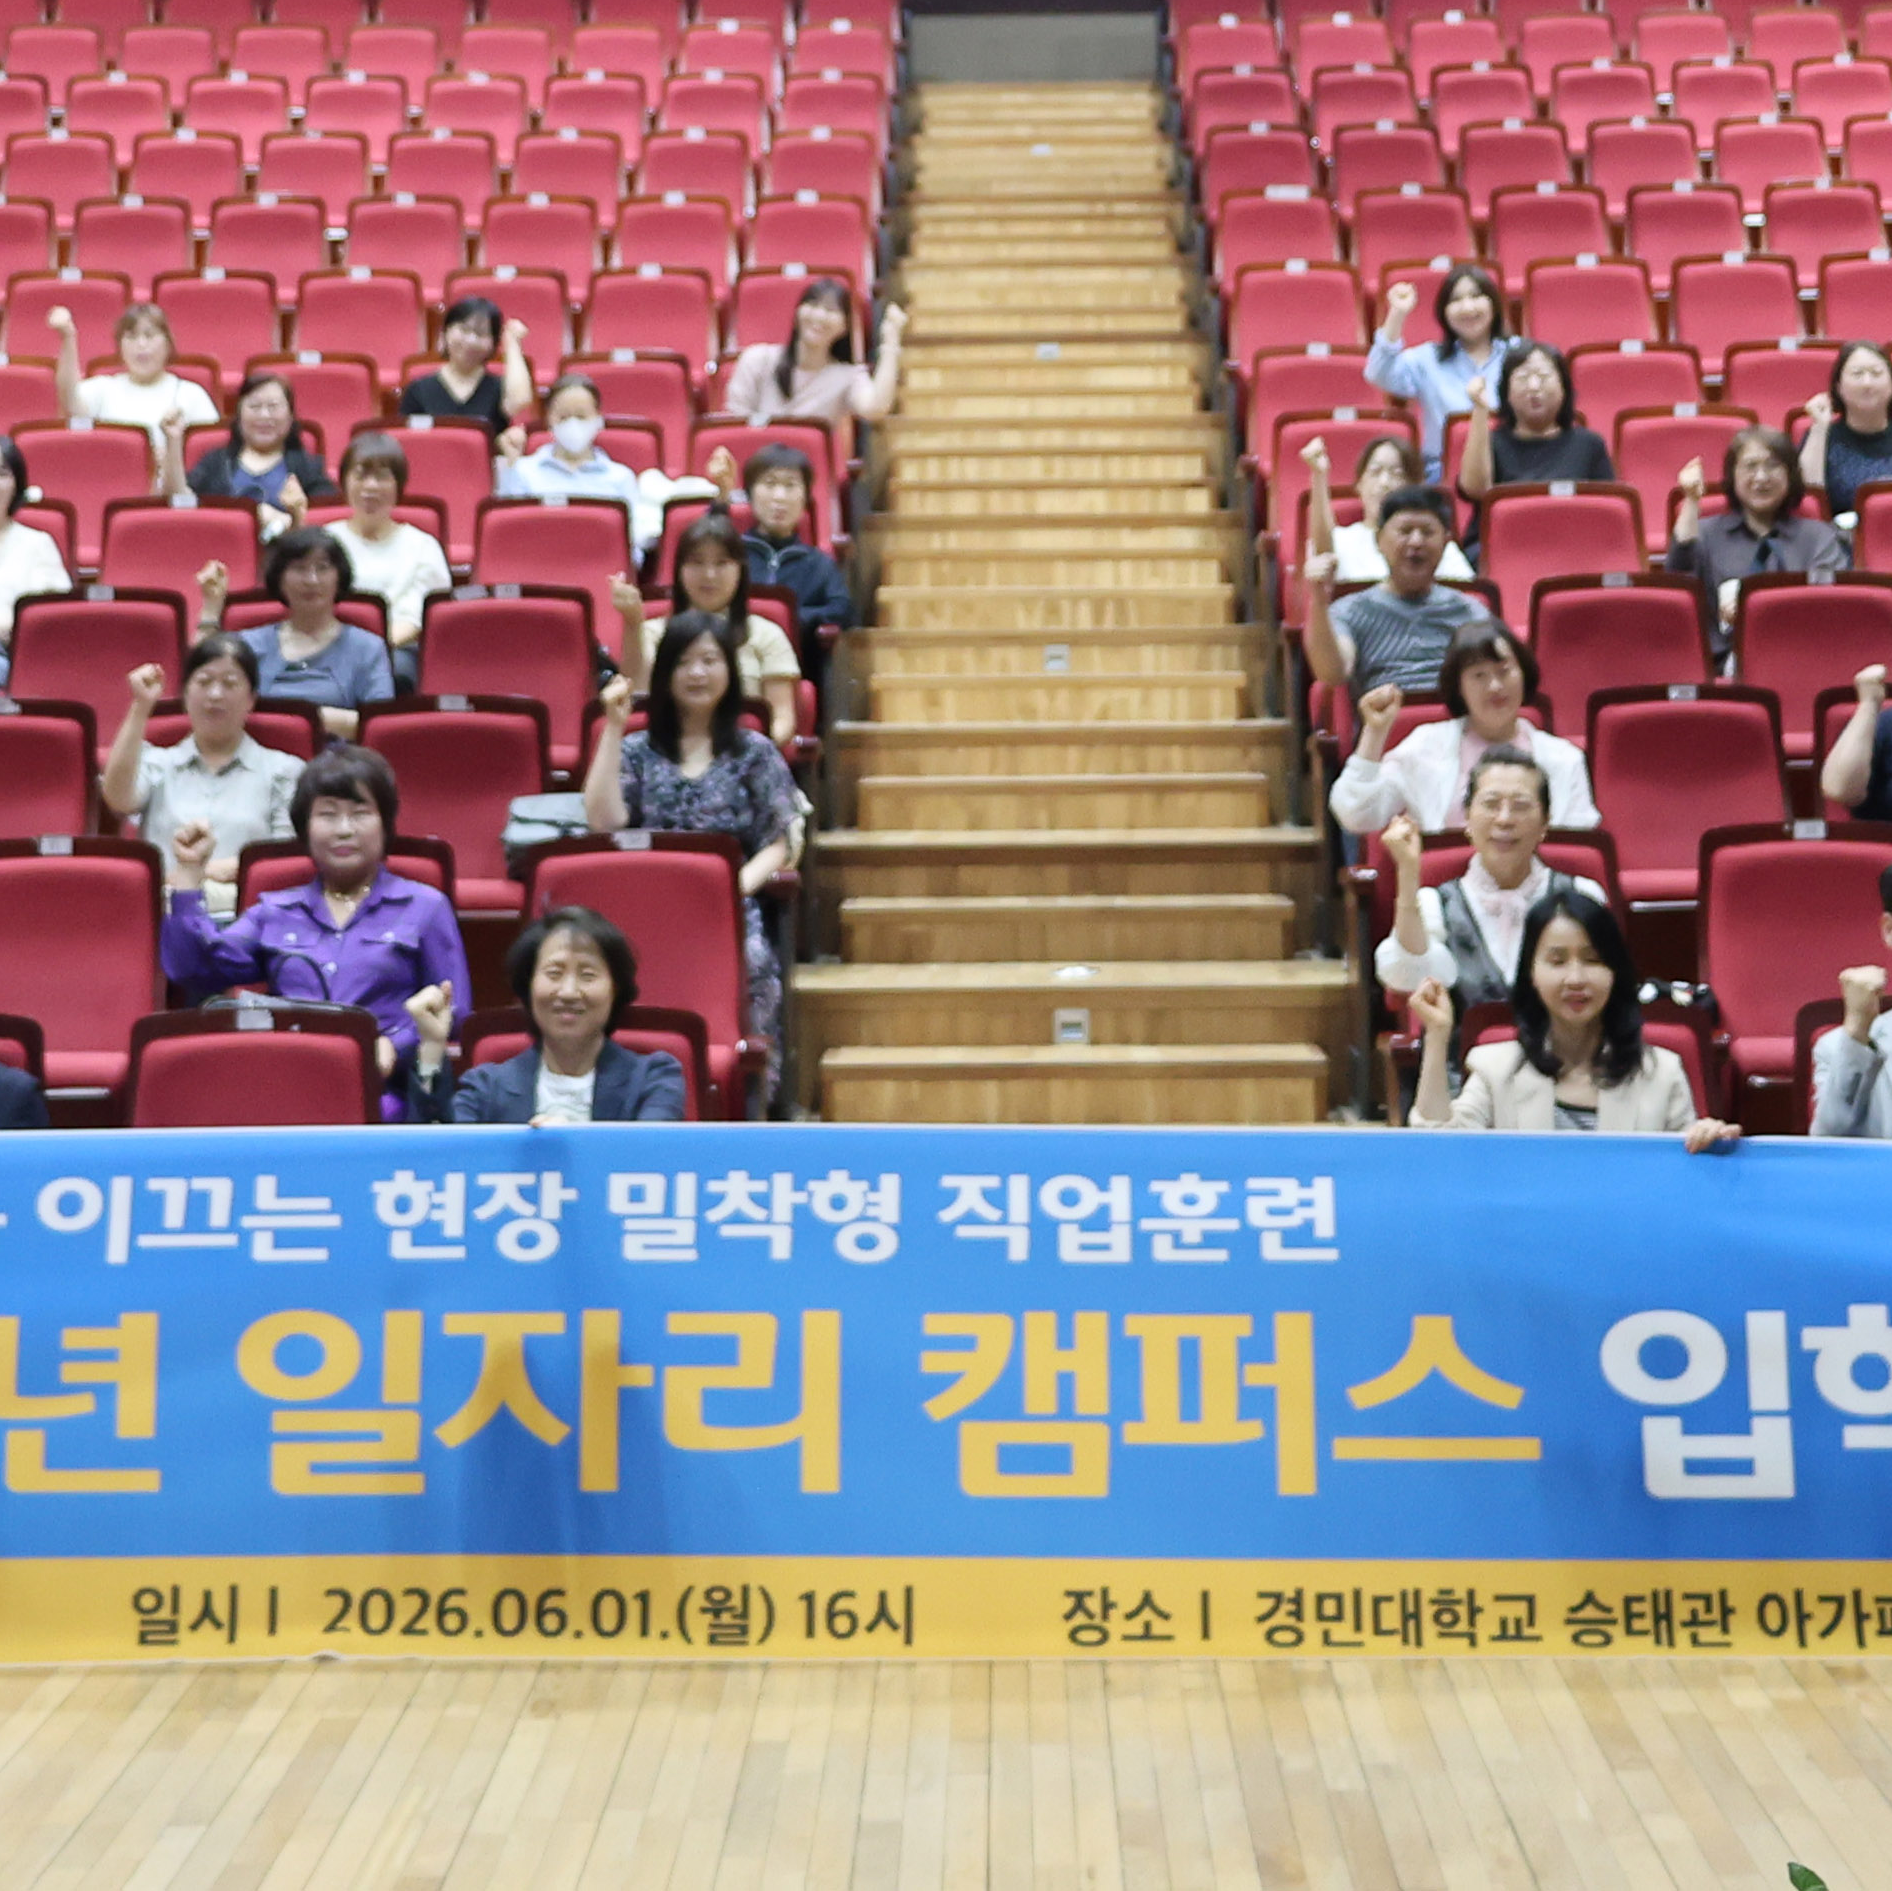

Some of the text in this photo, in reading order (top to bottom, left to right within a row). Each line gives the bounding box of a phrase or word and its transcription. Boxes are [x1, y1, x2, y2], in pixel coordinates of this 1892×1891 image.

[35, 1173, 344, 1266] 이끄는
[370, 1168, 580, 1264] 현장
[606, 1168, 903, 1266] 밀착형
[936, 1171, 1341, 1265] 직업훈련
[234, 1307, 844, 1498] 일자리
[918, 1308, 1543, 1500] 캠퍼스
[131, 1583, 914, 1647] 일시 2026.06.01.(월) 16시
[1062, 1586, 1175, 1648] 장소
[1255, 1587, 1543, 1649] 경민대학교
[1563, 1587, 1738, 1649] 승태관
